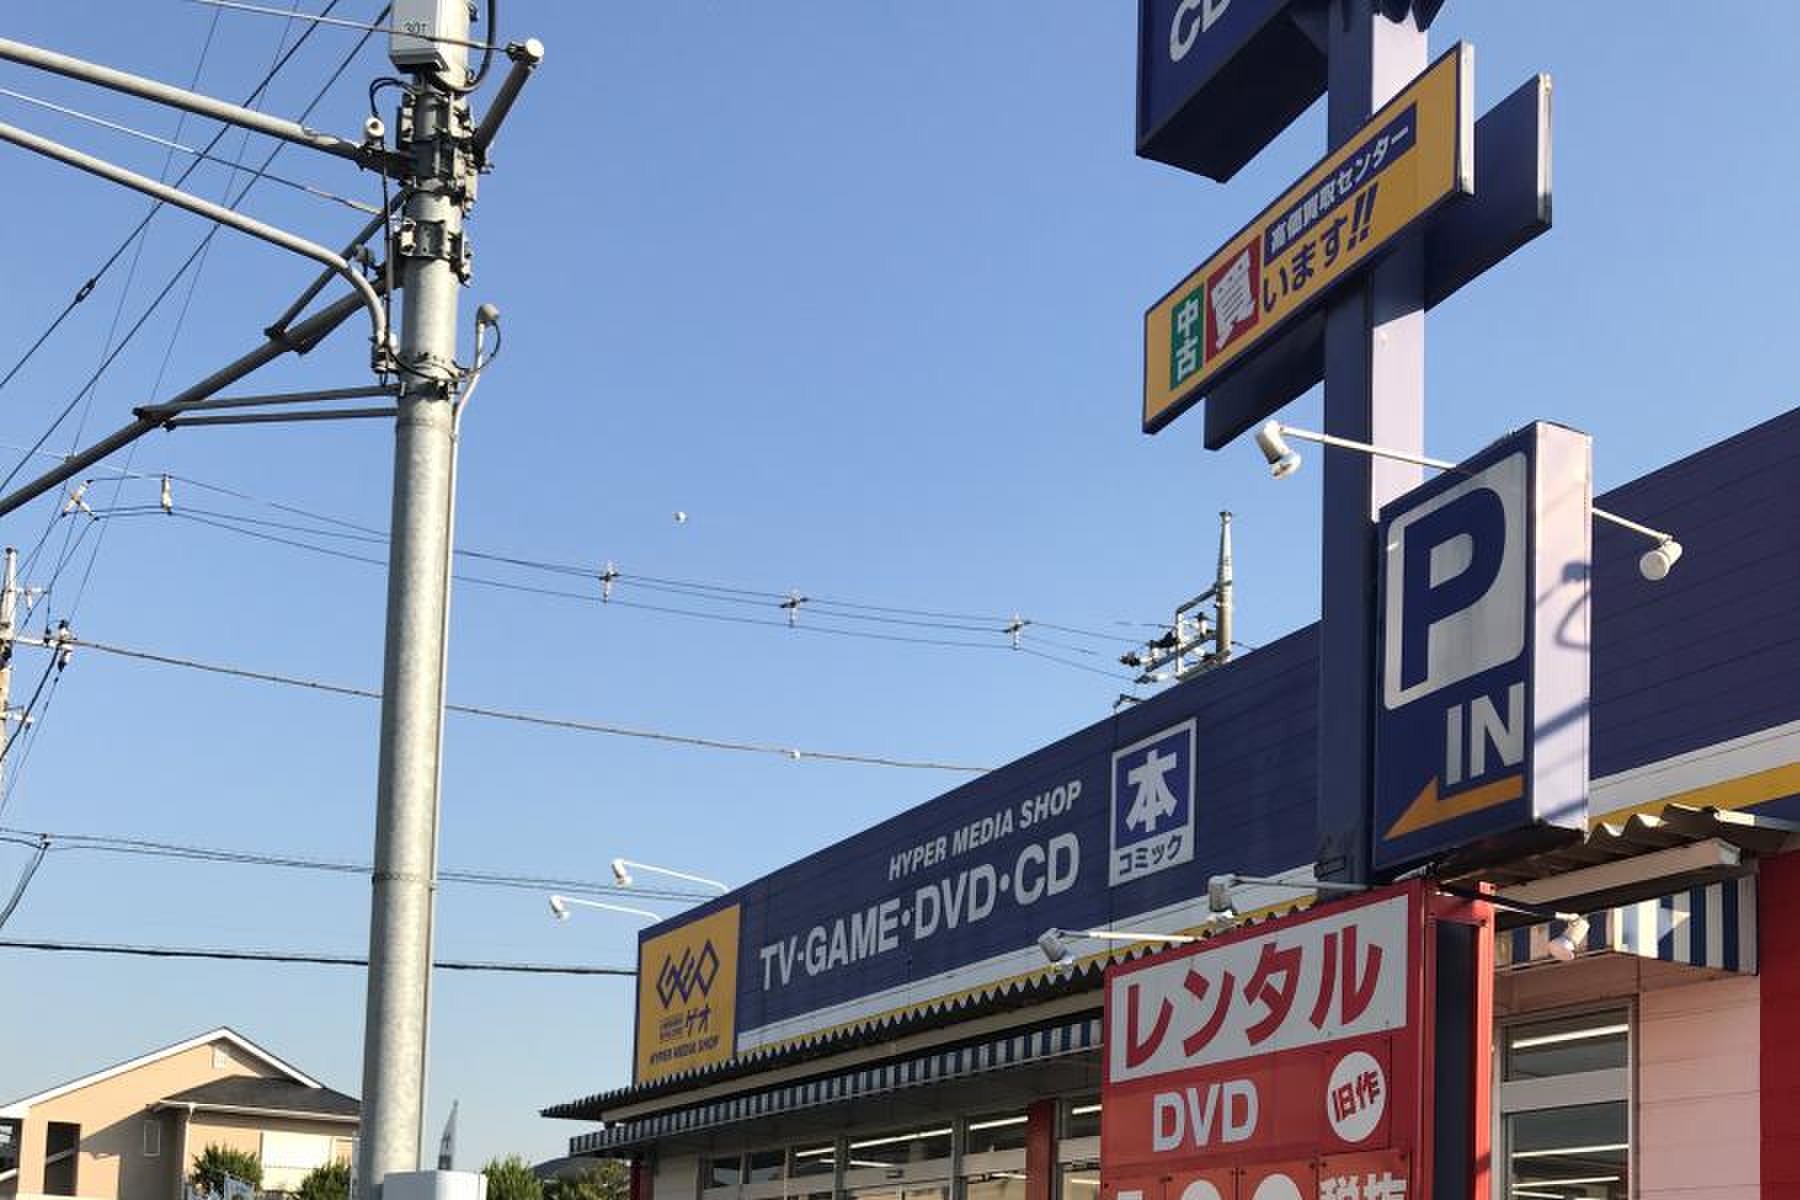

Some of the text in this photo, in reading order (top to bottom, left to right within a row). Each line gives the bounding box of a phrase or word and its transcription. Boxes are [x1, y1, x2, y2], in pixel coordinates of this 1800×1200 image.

[1174, 297, 1199, 382] 中古
[1400, 487, 1506, 692] P
[1447, 682, 1525, 786] IN
[888, 780, 1082, 881] HYPER MEDIA SHOP
[1126, 749, 1178, 833] 本
[1119, 834, 1183, 877] コミック
[1126, 924, 1384, 1070] レンタル
[1152, 1079, 1260, 1153] DVD
[1331, 1071, 1381, 1124] 旧作
